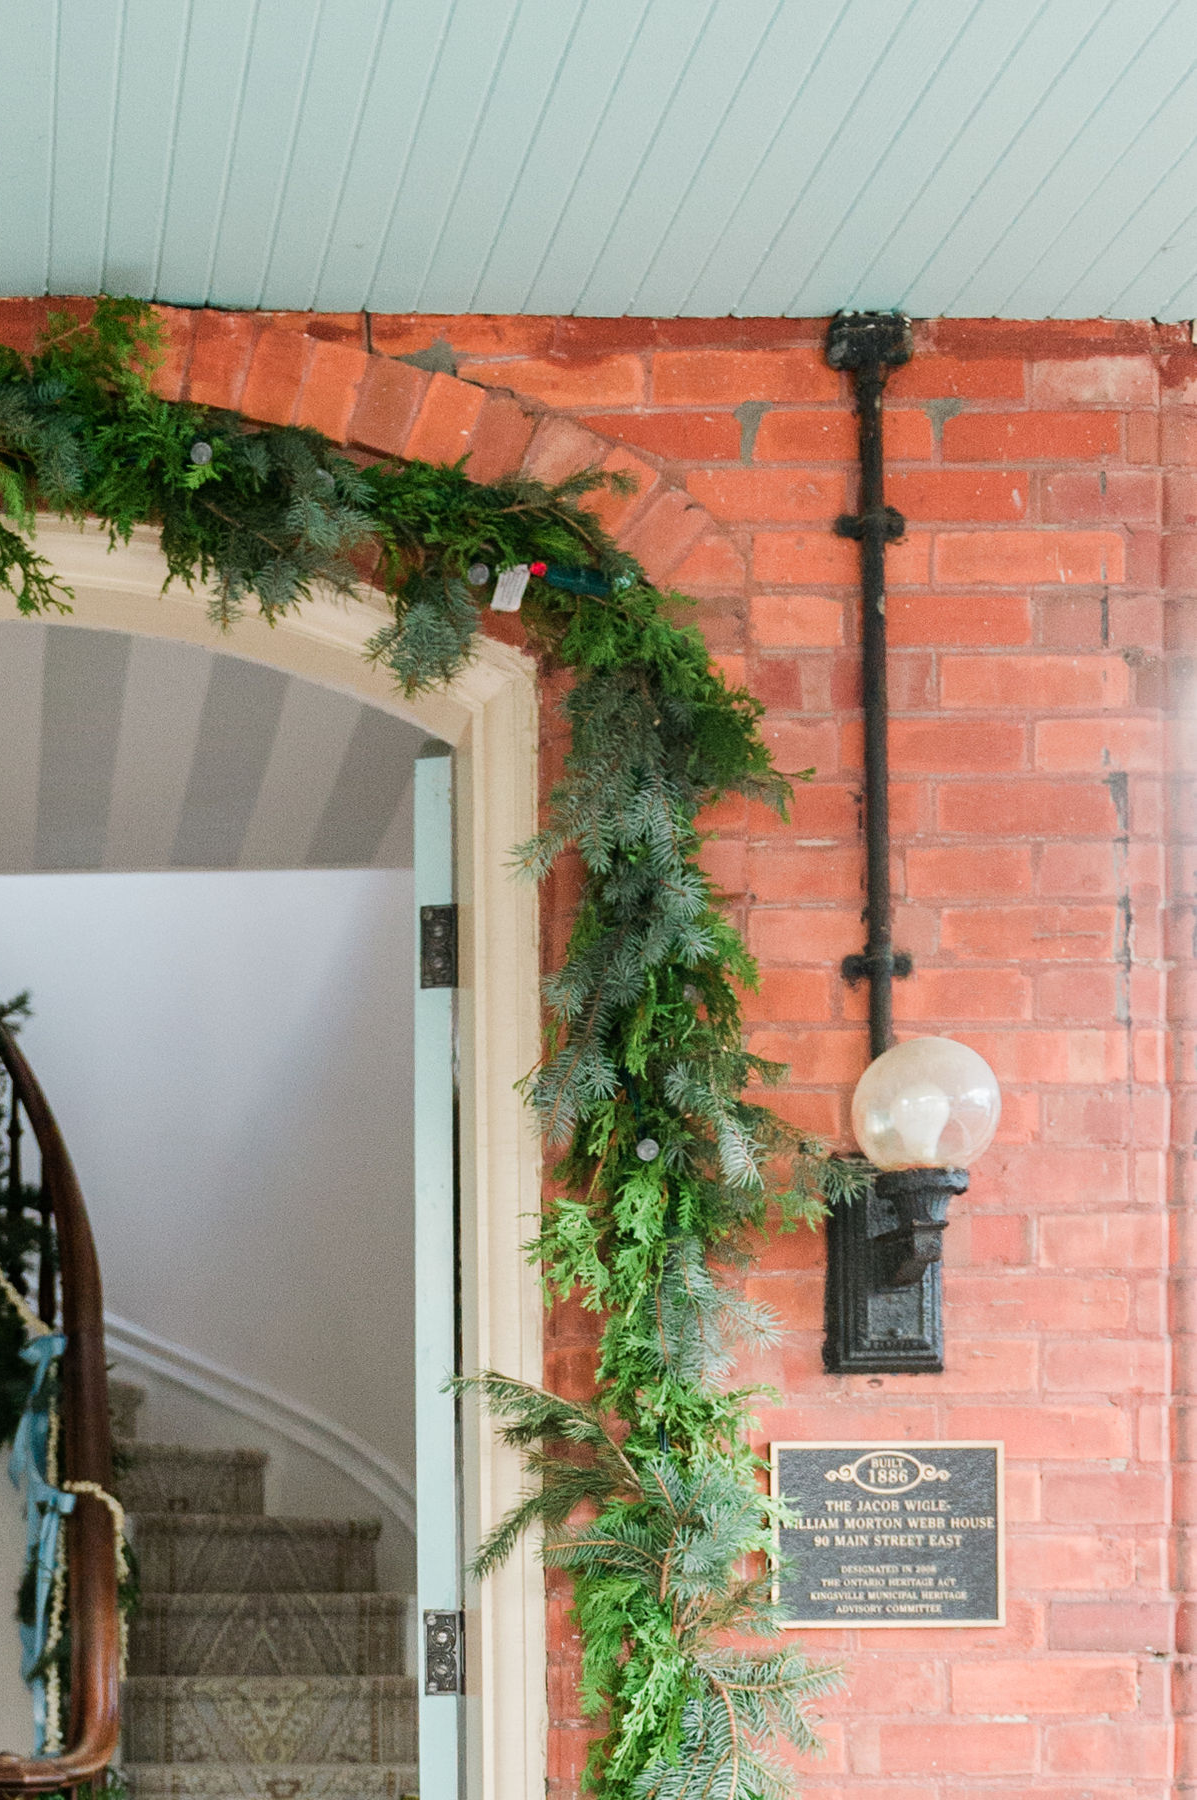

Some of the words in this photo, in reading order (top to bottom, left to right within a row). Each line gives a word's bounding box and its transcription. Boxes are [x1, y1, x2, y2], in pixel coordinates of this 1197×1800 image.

[871, 1458, 905, 1468] BUILT
[867, 1469, 908, 1484] 1886
[825, 1500, 852, 1512] THE
[856, 1500, 900, 1512] JACOB
[844, 1517, 902, 1529] MORTON
[907, 1517, 945, 1529] WEBB
[951, 1517, 995, 1529] HOUSE
[814, 1535, 830, 1547] 90
[834, 1535, 869, 1547] MAIN
[874, 1535, 923, 1547] STREET
[928, 1535, 963, 1547] EAST
[840, 1565, 899, 1574] DESIGNATED
[901, 1565, 913, 1574] IN
[821, 1578, 841, 1587] THE
[843, 1578, 885, 1587] ONTARIO
[888, 1578, 934, 1587] HERITAGE
[938, 1577, 957, 1587] ACT
[810, 1591, 865, 1601] KINGSVILLE
[867, 1591, 918, 1601] MUNICIPAL
[921, 1591, 968, 1601] HERITAGE
[835, 1604, 883, 1614] ADVISORY
[886, 1604, 943, 1614] COMMITTEE
